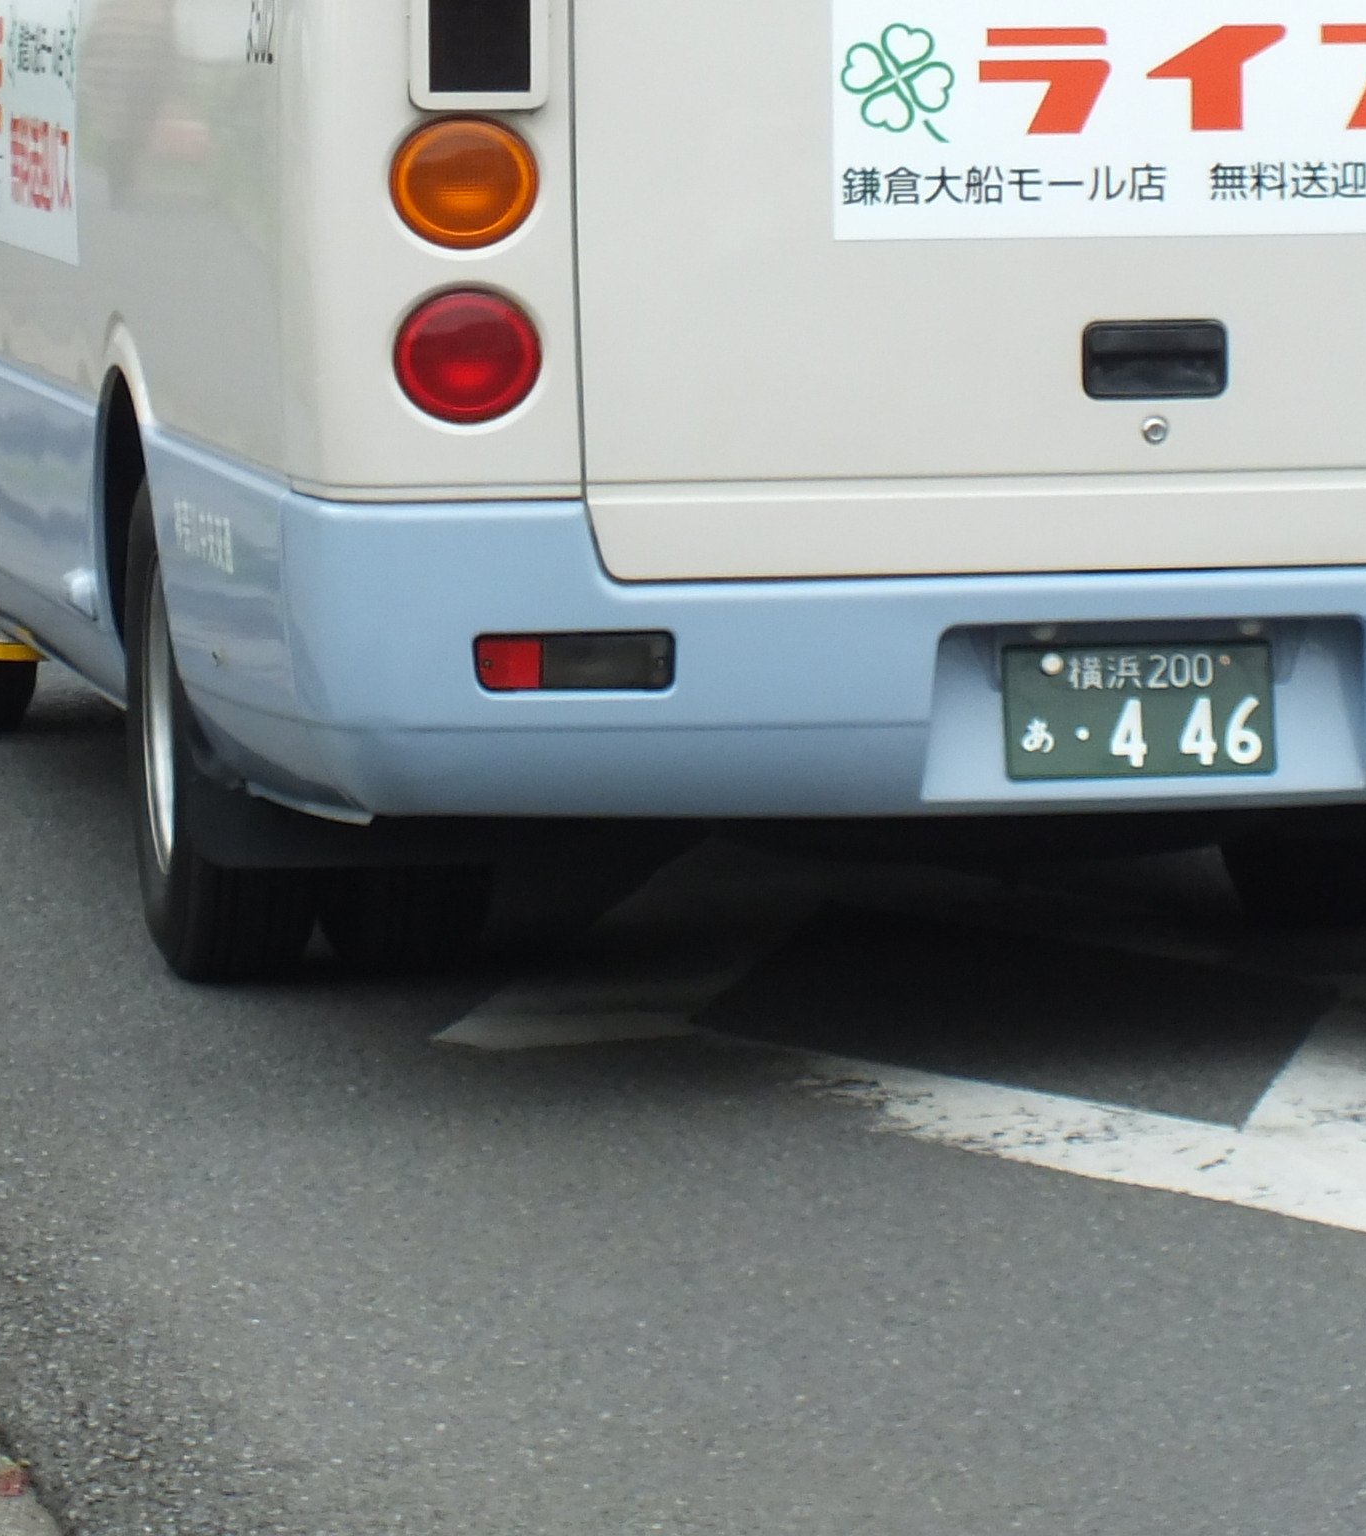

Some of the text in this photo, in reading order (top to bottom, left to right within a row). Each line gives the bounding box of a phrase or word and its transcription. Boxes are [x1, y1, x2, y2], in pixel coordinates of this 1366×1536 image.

[841, 163, 1168, 207] 鎌倉大船モール店
[1021, 716, 1055, 754] あ
